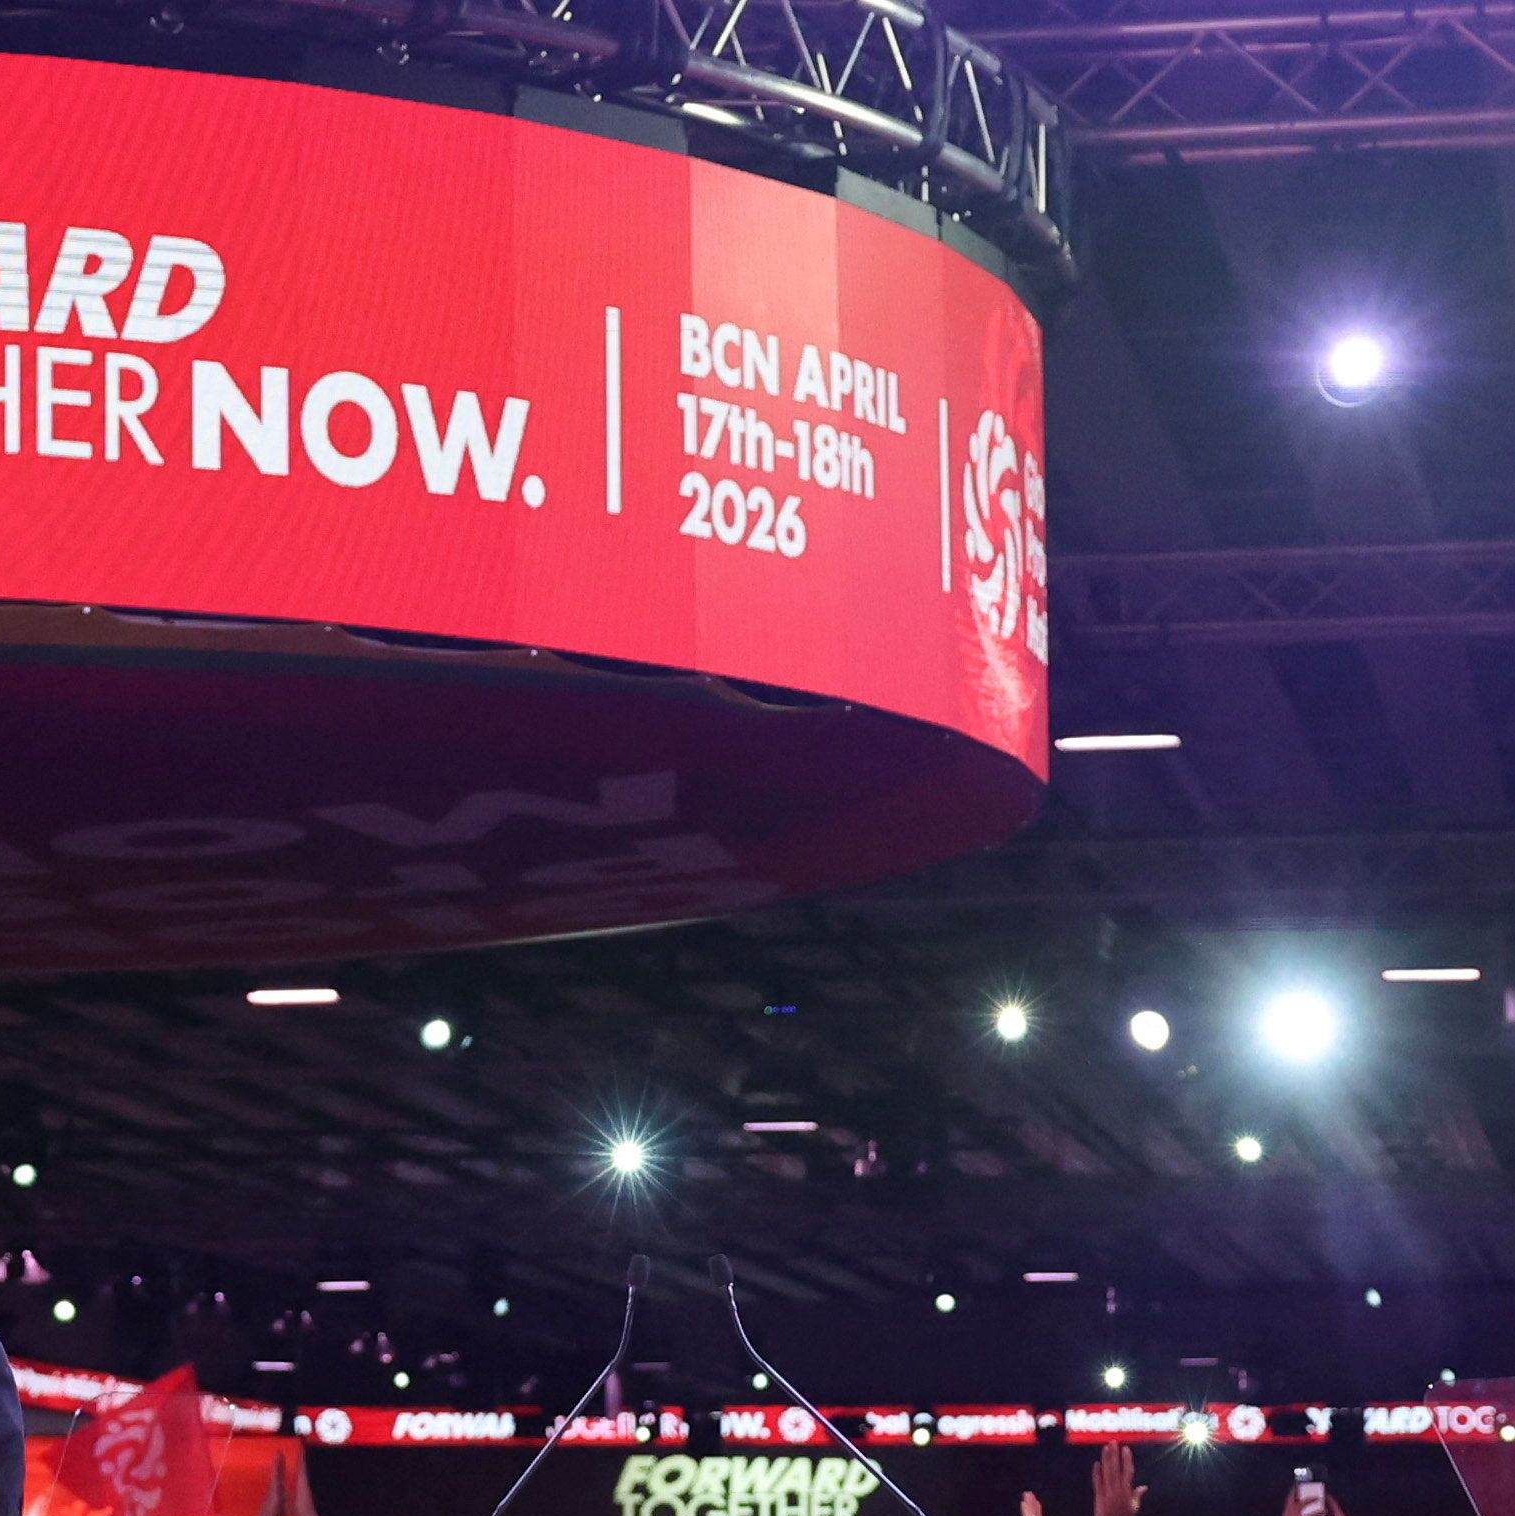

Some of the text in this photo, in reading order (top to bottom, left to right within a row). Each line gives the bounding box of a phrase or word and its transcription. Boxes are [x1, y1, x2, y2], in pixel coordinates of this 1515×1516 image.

[679, 313, 907, 436] BCN APRIL
[191, 360, 547, 510] NOW.
[677, 392, 875, 499] 17th-18th
[679, 471, 807, 559] 2026
[613, 1454, 882, 1497] FORWARD
